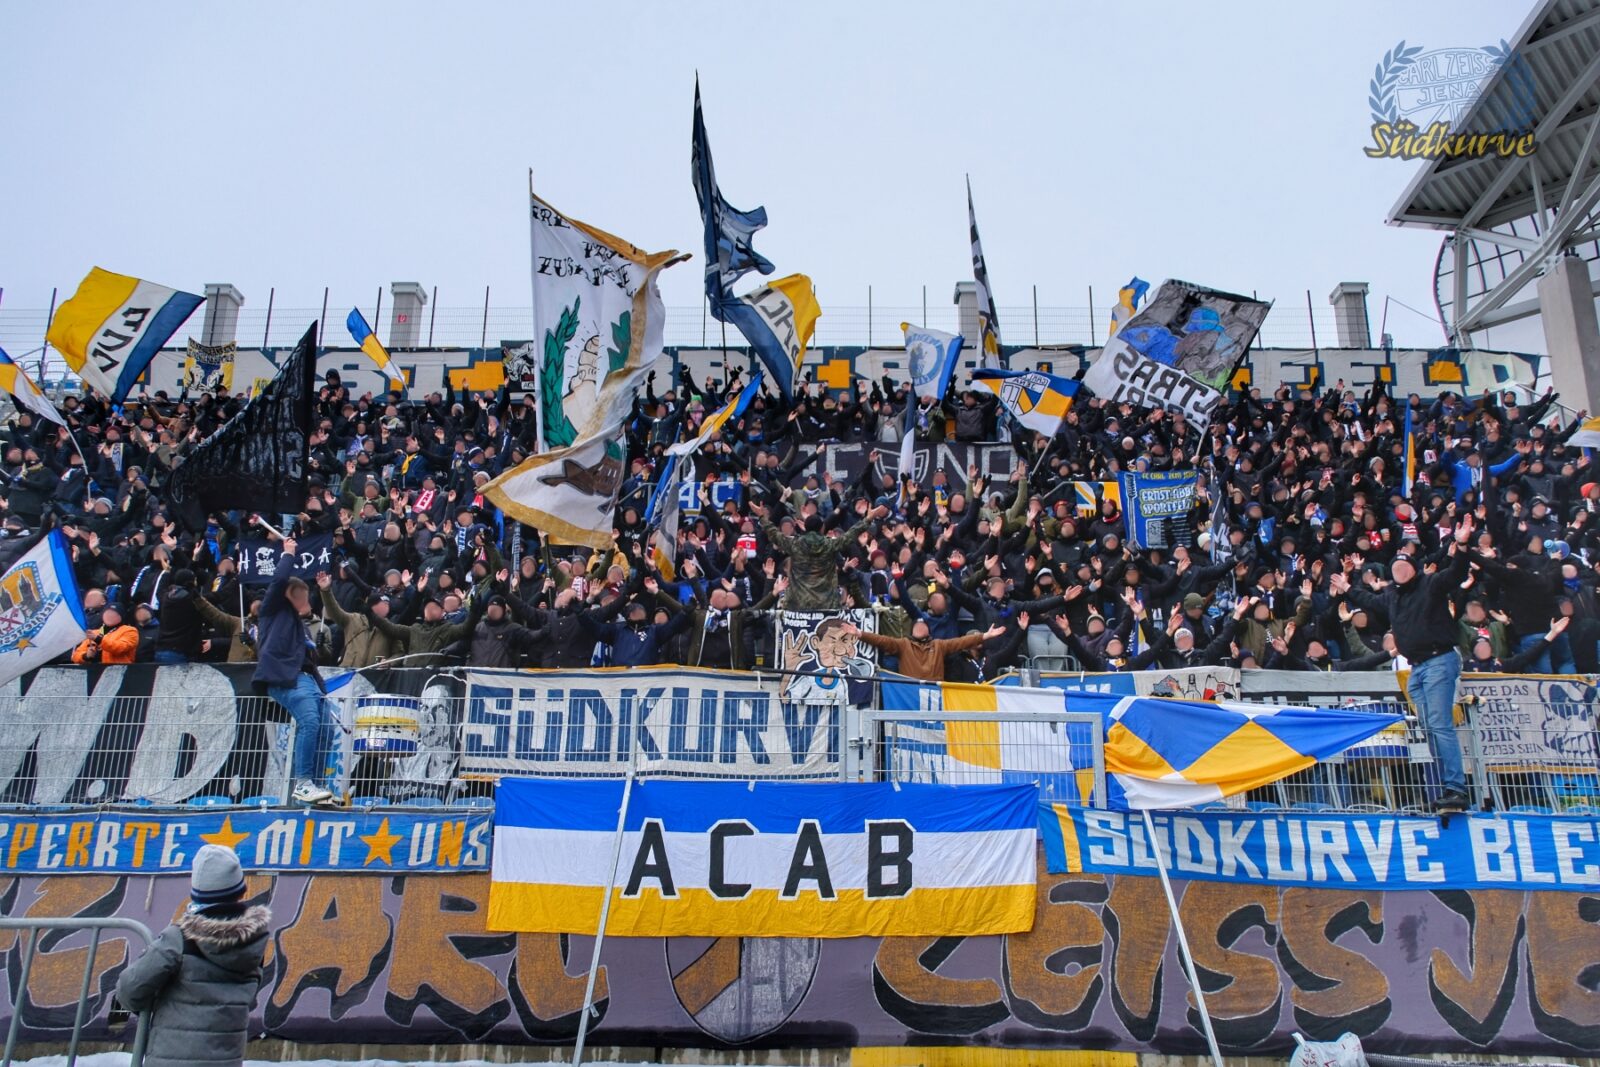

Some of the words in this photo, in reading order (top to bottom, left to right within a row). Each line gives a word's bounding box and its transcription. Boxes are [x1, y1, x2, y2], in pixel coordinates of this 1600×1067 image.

[796, 611, 811, 620] LONG
[811, 612, 824, 620] AND
[1459, 685, 1498, 697] UTZE
[1501, 684, 1529, 697] DAS
[1476, 698, 1520, 713] PIEL
[1478, 714, 1531, 726] ÖNNTE
[256, 818, 355, 867] MIT
[408, 820, 490, 868] UNS
[620, 817, 916, 901] ACAB
[1084, 810, 1446, 883] SÜDKURVE
[1467, 816, 1600, 884] BLE
[172, 875, 608, 1038] ARL
